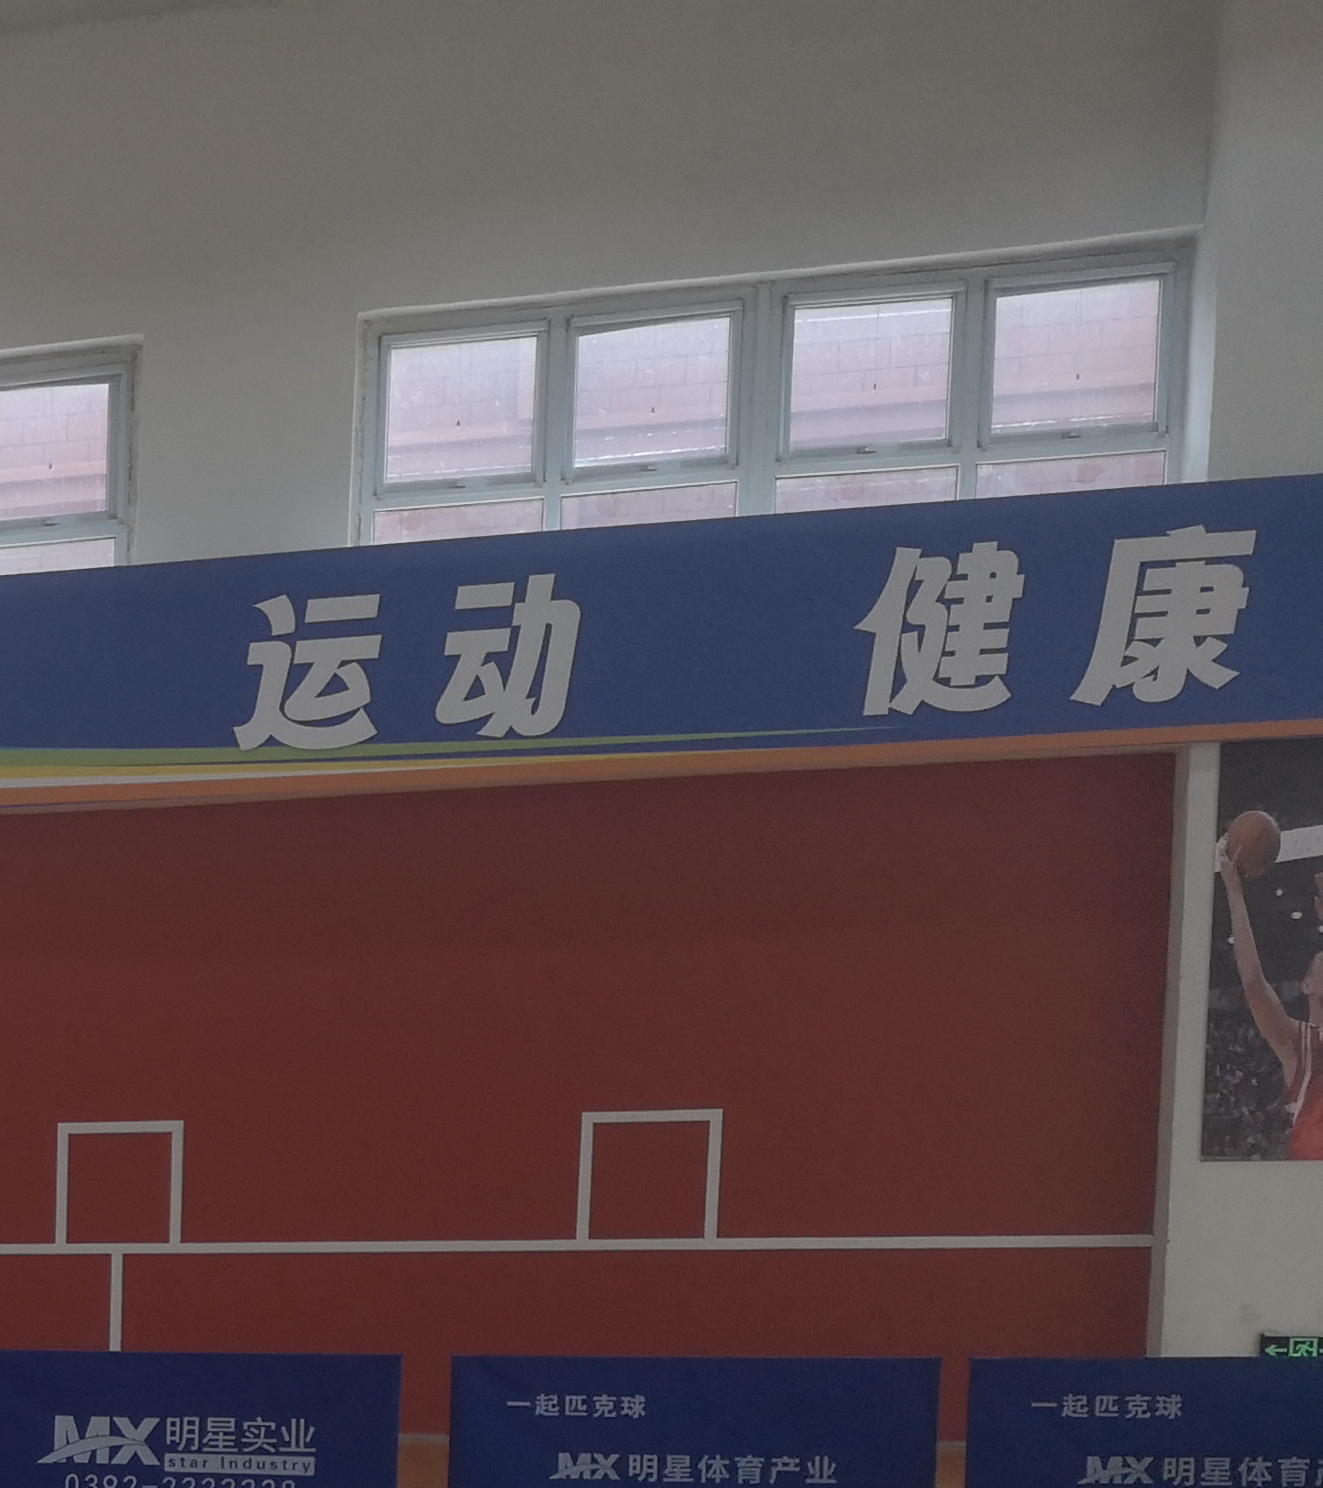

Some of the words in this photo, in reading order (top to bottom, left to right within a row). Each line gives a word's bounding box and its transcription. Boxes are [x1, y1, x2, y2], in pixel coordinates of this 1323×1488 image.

[235, 574, 582, 750] 运动
[854, 525, 1257, 716] 健康
[506, 1393, 647, 1419] 一起匹克球
[1031, 1393, 1183, 1420] 一起匹克球
[37, 1415, 161, 1466] MX
[165, 1416, 317, 1453] 明星实业
[220, 1456, 312, 1476] Industry
[549, 1452, 621, 1481] MX
[627, 1453, 839, 1485] 明星体育产业
[1077, 1455, 1154, 1485] MX
[1162, 1456, 1323, 1488] 明星体育
